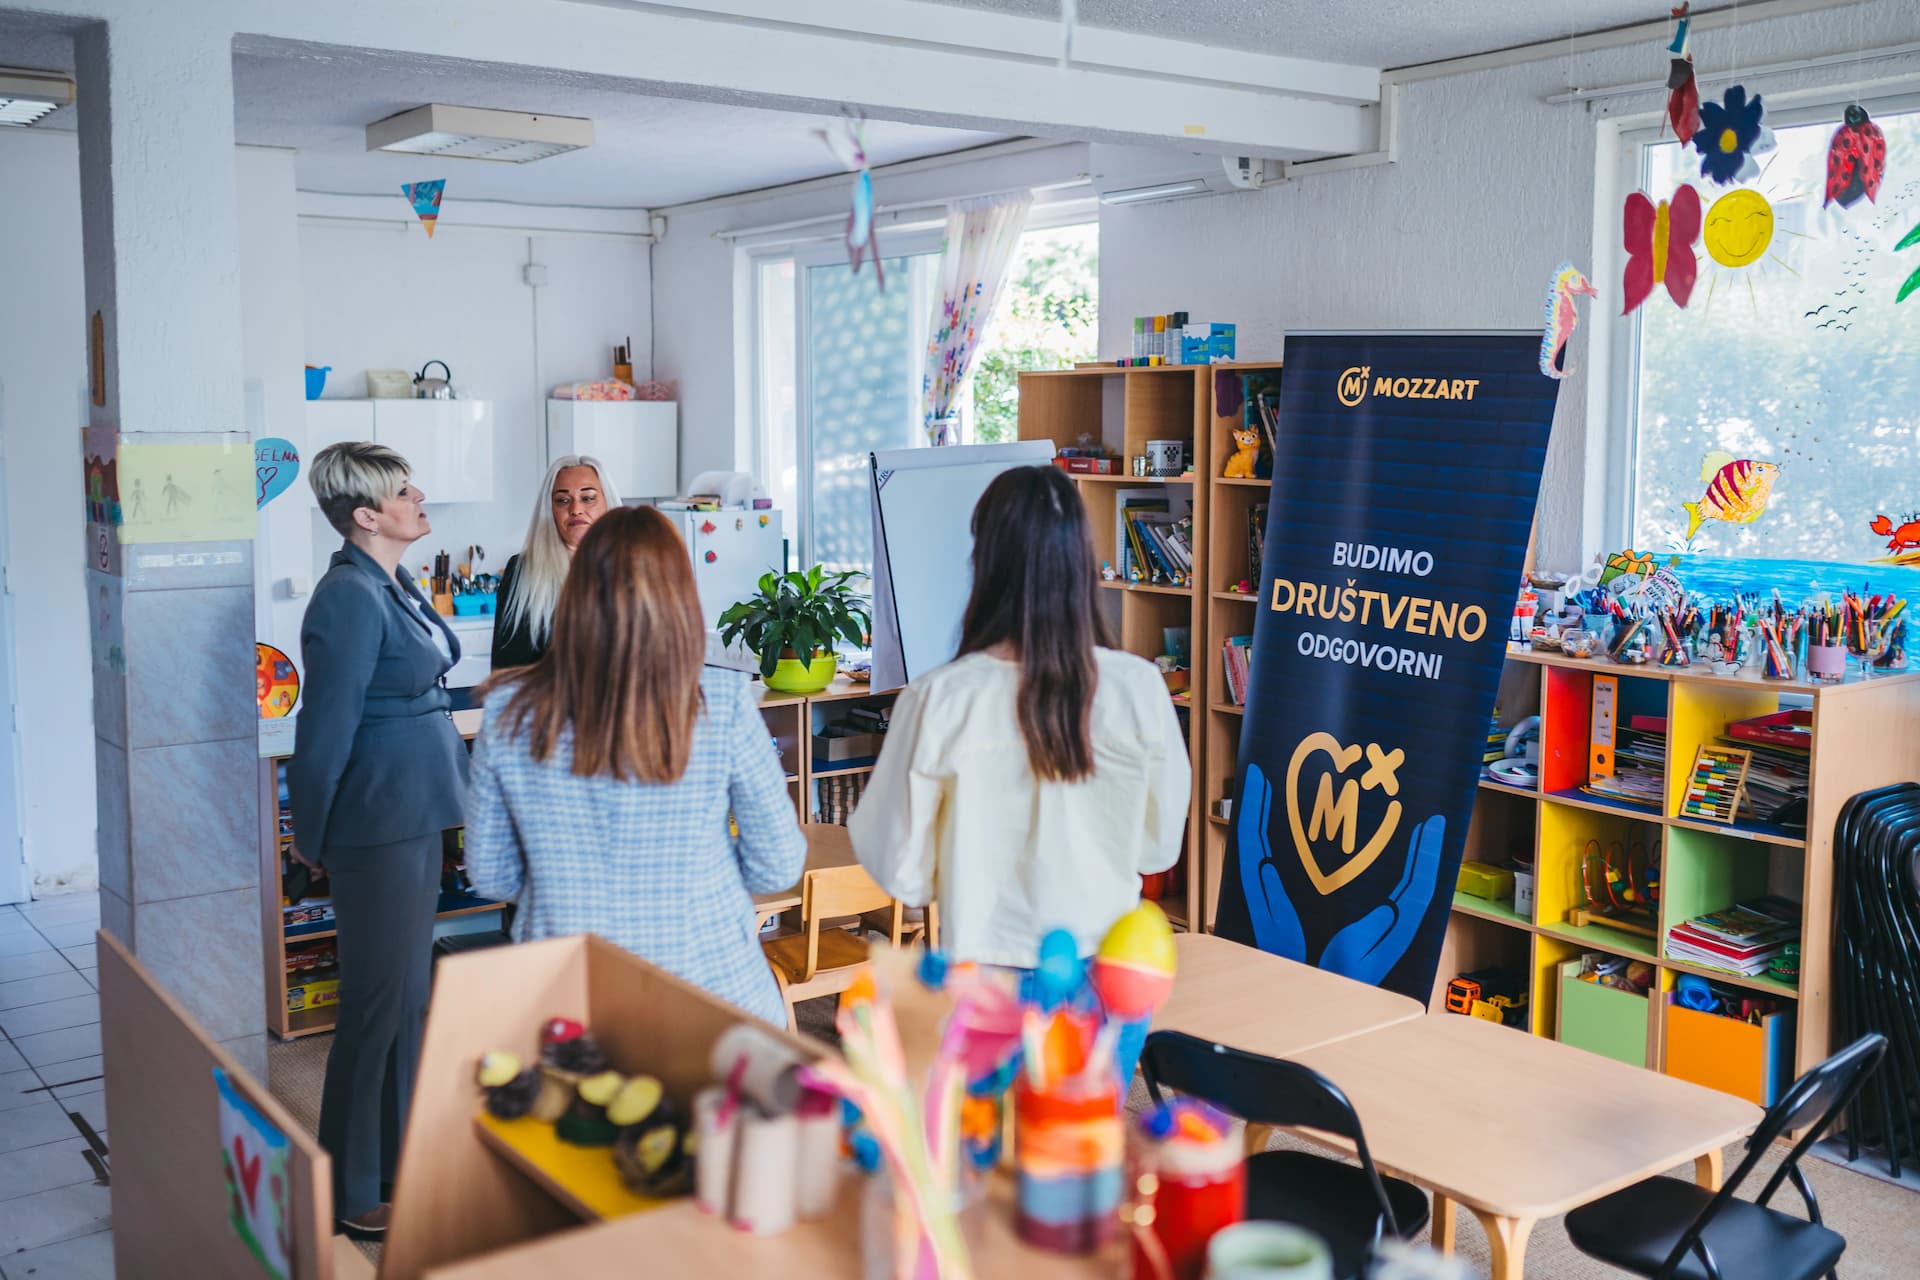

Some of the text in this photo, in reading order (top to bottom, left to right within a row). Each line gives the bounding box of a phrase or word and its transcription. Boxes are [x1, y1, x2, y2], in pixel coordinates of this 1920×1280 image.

[1372, 377, 1480, 401] MOZZART
[1332, 541, 1434, 577] BUDIMO
[1271, 578, 1487, 642] DRUŠTVENO
[1297, 631, 1444, 681] ODGOVORNI
